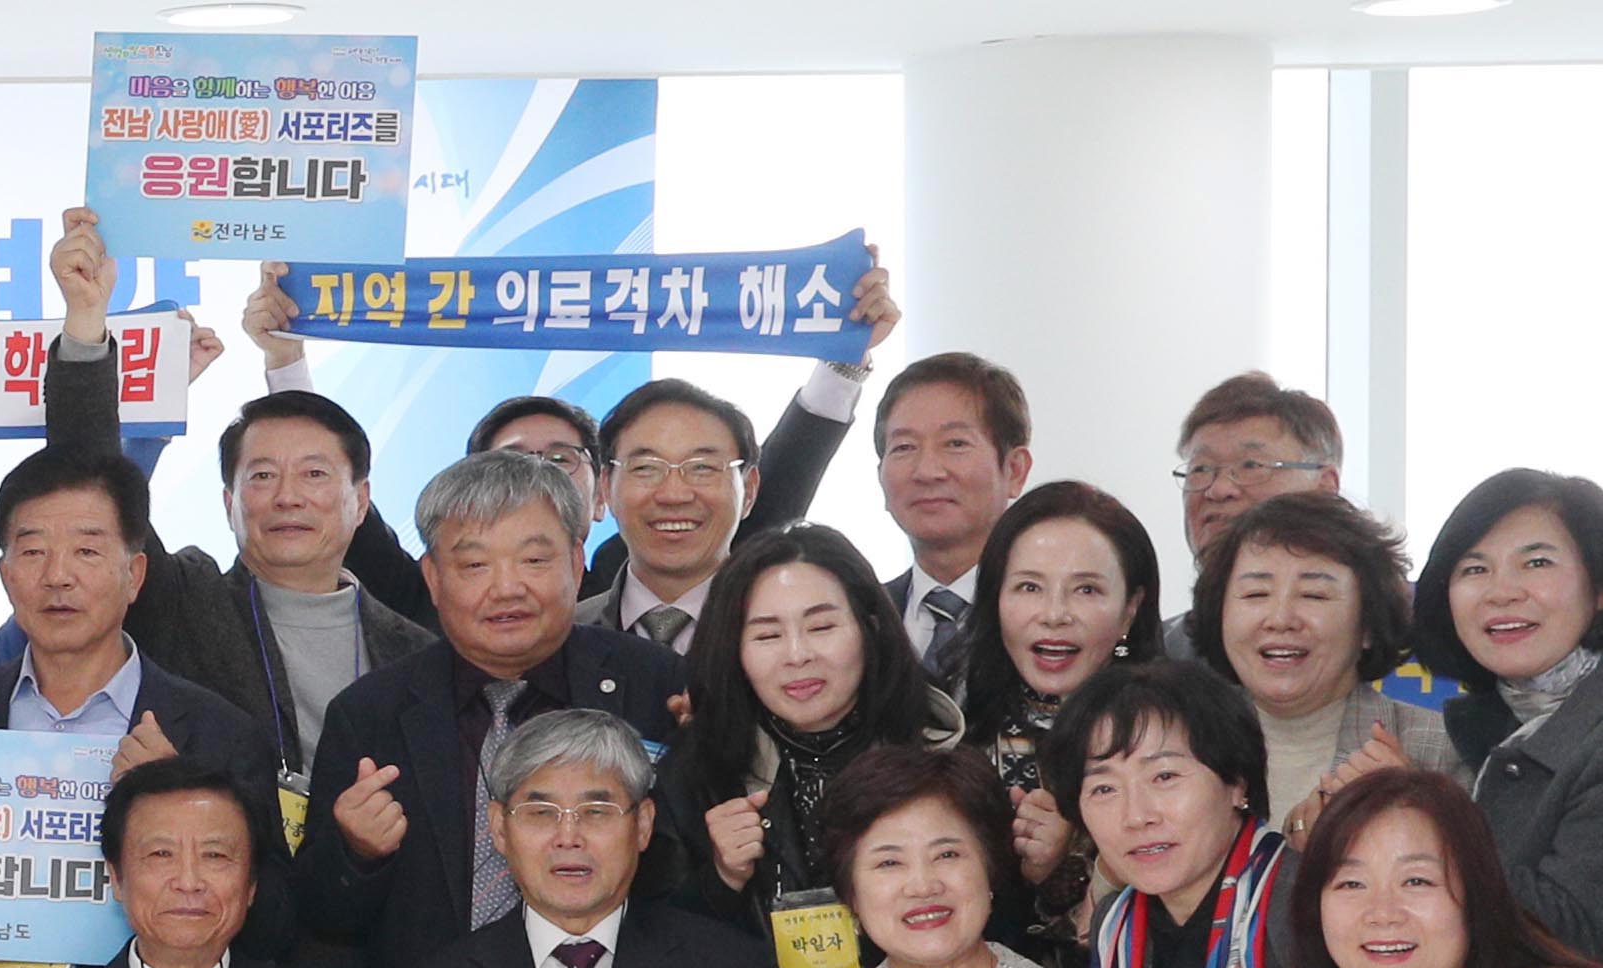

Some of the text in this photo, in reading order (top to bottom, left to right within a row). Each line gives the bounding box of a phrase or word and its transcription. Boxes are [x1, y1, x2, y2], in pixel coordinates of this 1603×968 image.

[129, 75, 376, 101] 마음을 함께하는 행복한 이음
[103, 108, 398, 142] 전남 사랑애(愛) 서포터즈를
[143, 156, 366, 199] 응원합니다
[413, 169, 469, 198] 시대
[215, 223, 287, 240] 전라남도
[309, 263, 843, 335] 지역 간 의료격차 해소
[15, 775, 77, 799] 행복한
[791, 932, 844, 954] 박일자
